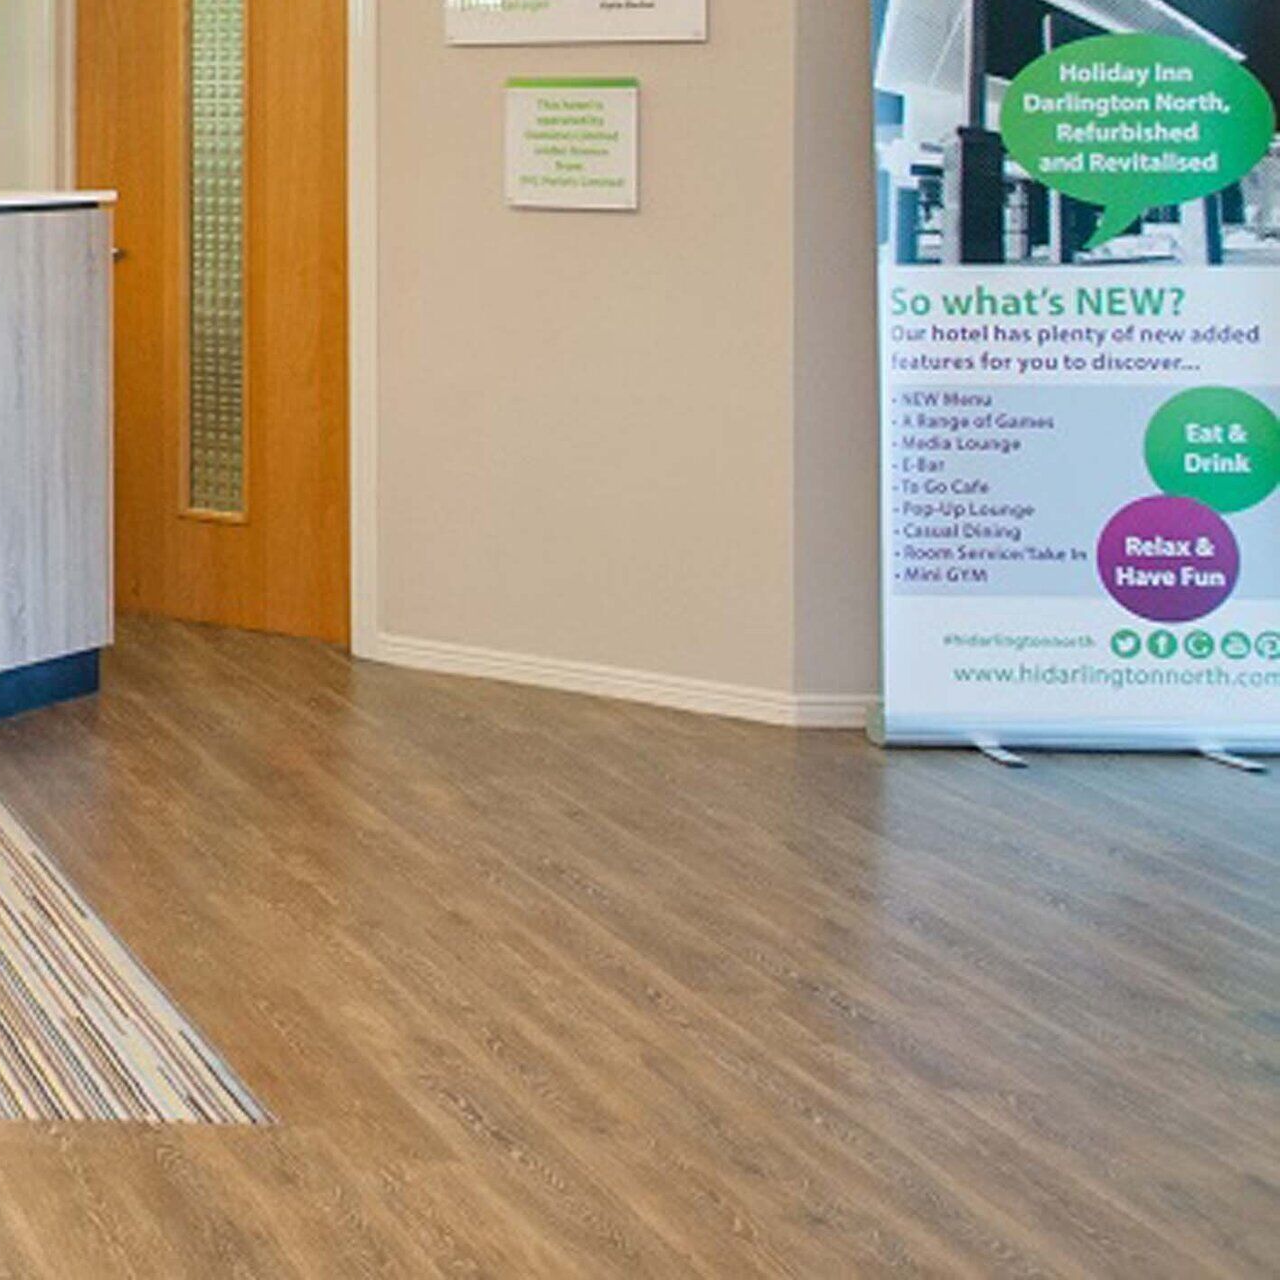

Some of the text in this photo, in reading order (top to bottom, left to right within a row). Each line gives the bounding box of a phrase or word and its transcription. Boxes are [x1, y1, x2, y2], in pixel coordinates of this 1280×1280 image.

[1059, 62, 1193, 88] Holiday Inn
[1022, 91, 1231, 117] Darlington North,
[1056, 121, 1200, 142] Refurbished
[1039, 151, 1219, 172] and Revitalised
[890, 286, 1185, 317] So what's NEW?
[891, 324, 1260, 346] Our hotel has plenty of new added
[891, 352, 975, 370] features
[981, 352, 1011, 370] for
[1016, 356, 1058, 373] you
[1064, 354, 1088, 370] to
[902, 392, 992, 407] NEW Menu
[917, 414, 969, 431] Range
[973, 414, 993, 428] of
[995, 413, 1054, 429] Games
[1184, 422, 1248, 444] Eat &
[902, 436, 1022, 454] Media Lounge
[1184, 452, 1252, 474] Drink
[924, 479, 948, 494] Go
[969, 502, 1036, 519] Lounge
[903, 523, 1022, 542] Casual Dining
[904, 545, 953, 561] Room
[1125, 536, 1216, 557] Relax &
[904, 566, 989, 582] Mini GYM
[1114, 566, 1226, 587] Have Fun
